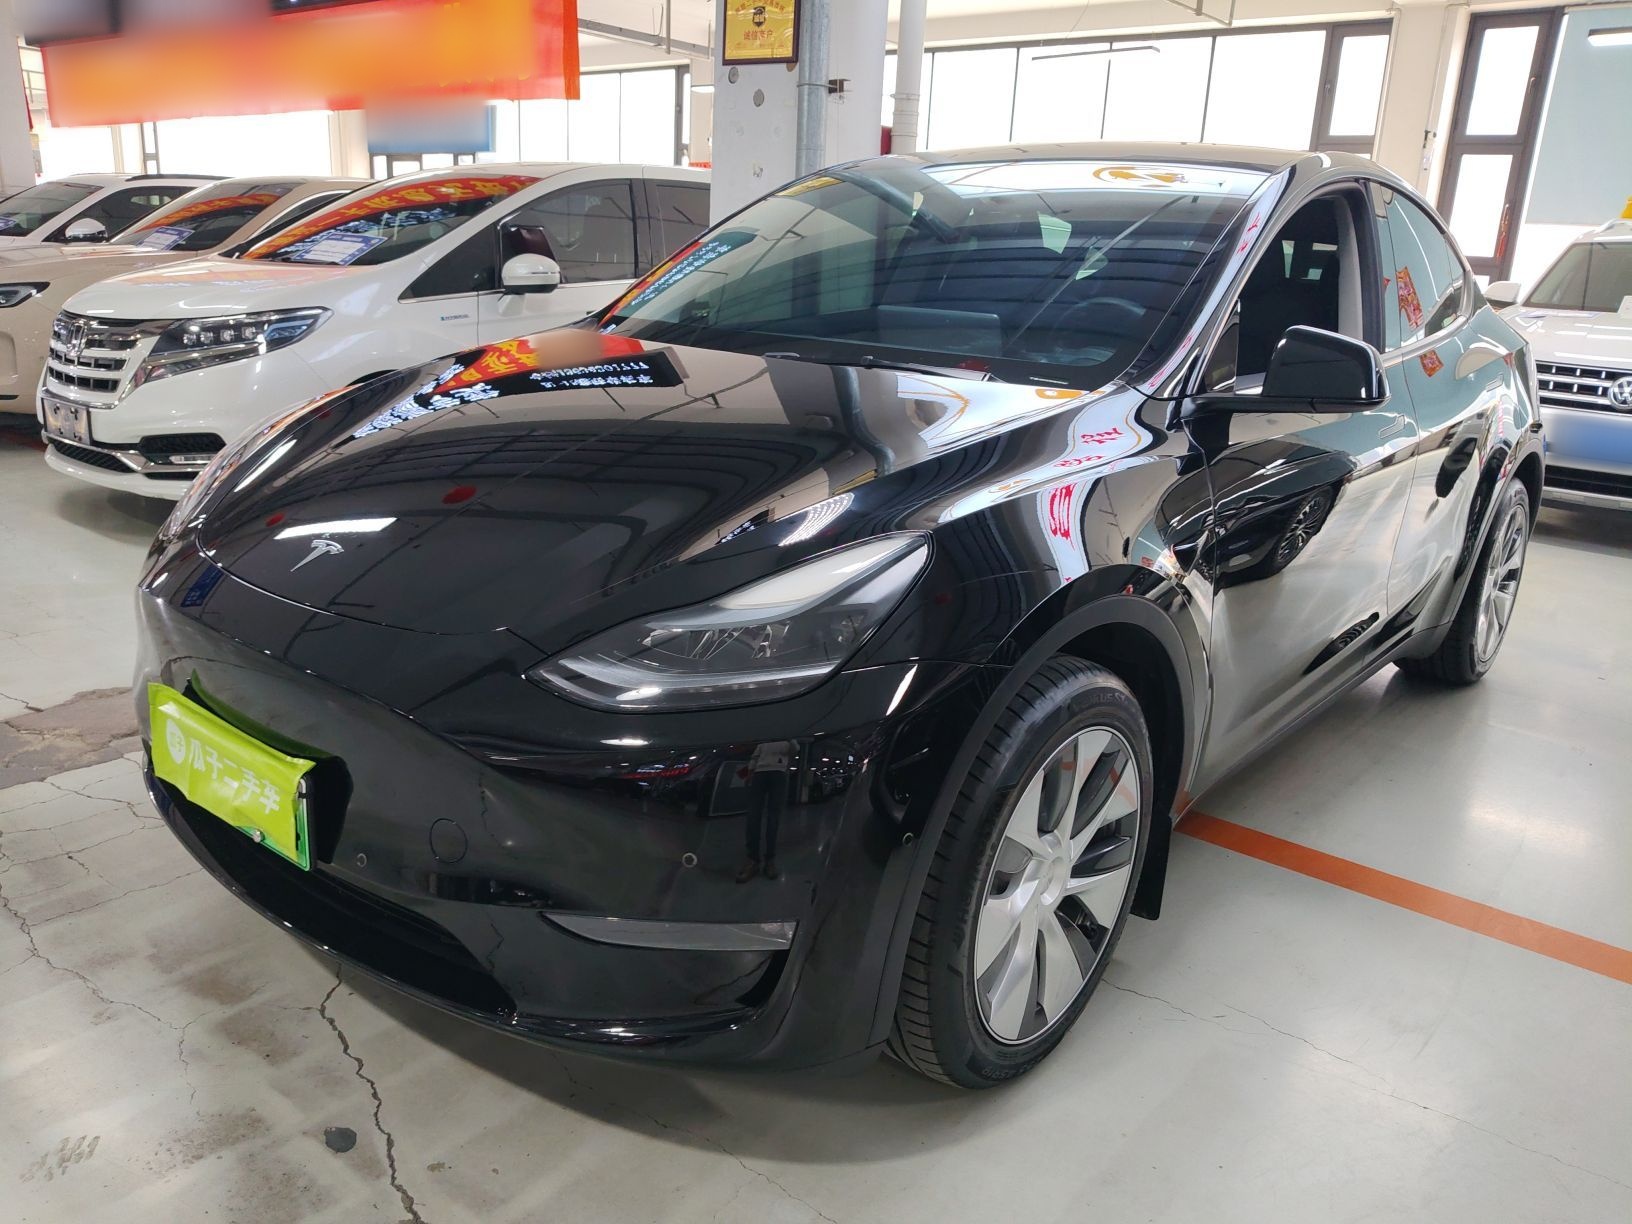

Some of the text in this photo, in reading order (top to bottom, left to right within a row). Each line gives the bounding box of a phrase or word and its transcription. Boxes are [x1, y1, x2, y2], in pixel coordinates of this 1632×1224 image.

[189, 739, 280, 814] 瓜子二手车
